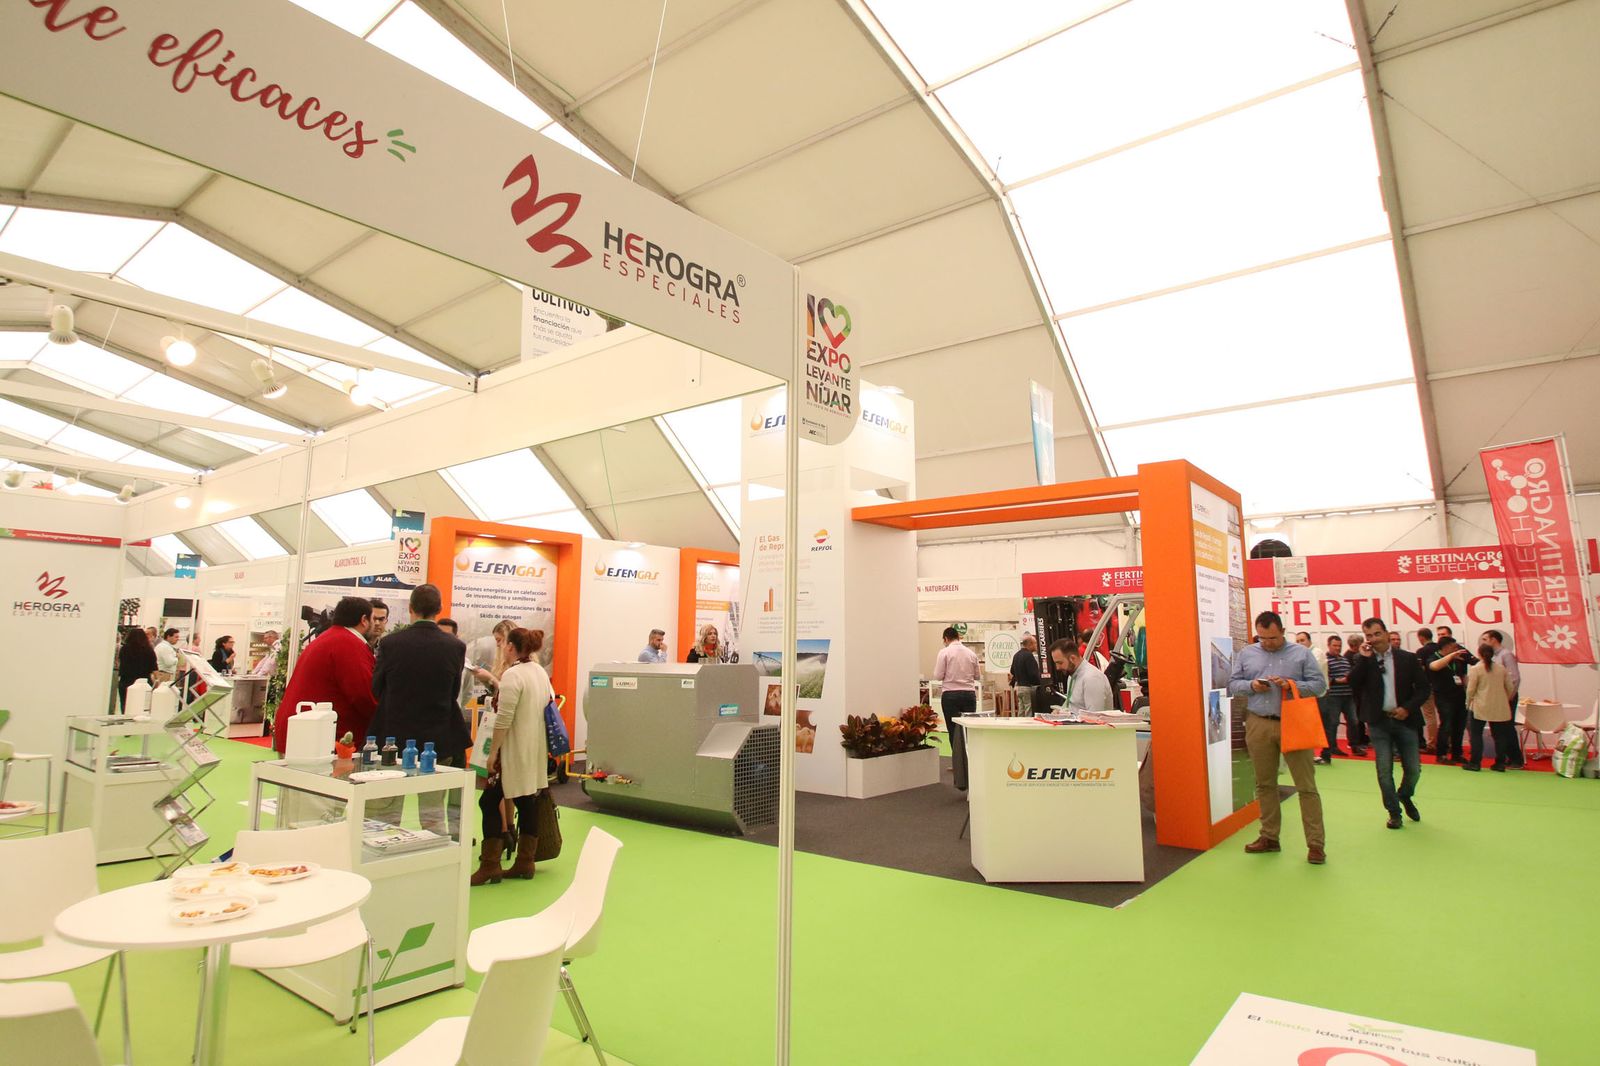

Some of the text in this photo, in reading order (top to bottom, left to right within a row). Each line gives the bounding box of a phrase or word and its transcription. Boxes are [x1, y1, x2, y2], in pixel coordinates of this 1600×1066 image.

[147, 28, 379, 159] eficaces
[603, 253, 741, 325] ESPECIALES
[806, 339, 852, 375] EXPO
[806, 362, 852, 392] LEVANTE
[805, 380, 852, 415] NÍJAR
[399, 552, 420, 561] EXPO
[473, 561, 547, 578] ESEMGAS
[607, 567, 660, 580] ESEMGAS
[1416, 561, 1477, 574] BIOTECH
[924, 584, 959, 592] NATURGREEN
[13, 601, 81, 613] HEROGRA
[1271, 594, 1515, 627] FERTINAG
[1027, 767, 1115, 780] ESEMGAS
[1315, 1029, 1354, 1042] ideal
[1358, 1038, 1395, 1052] para
